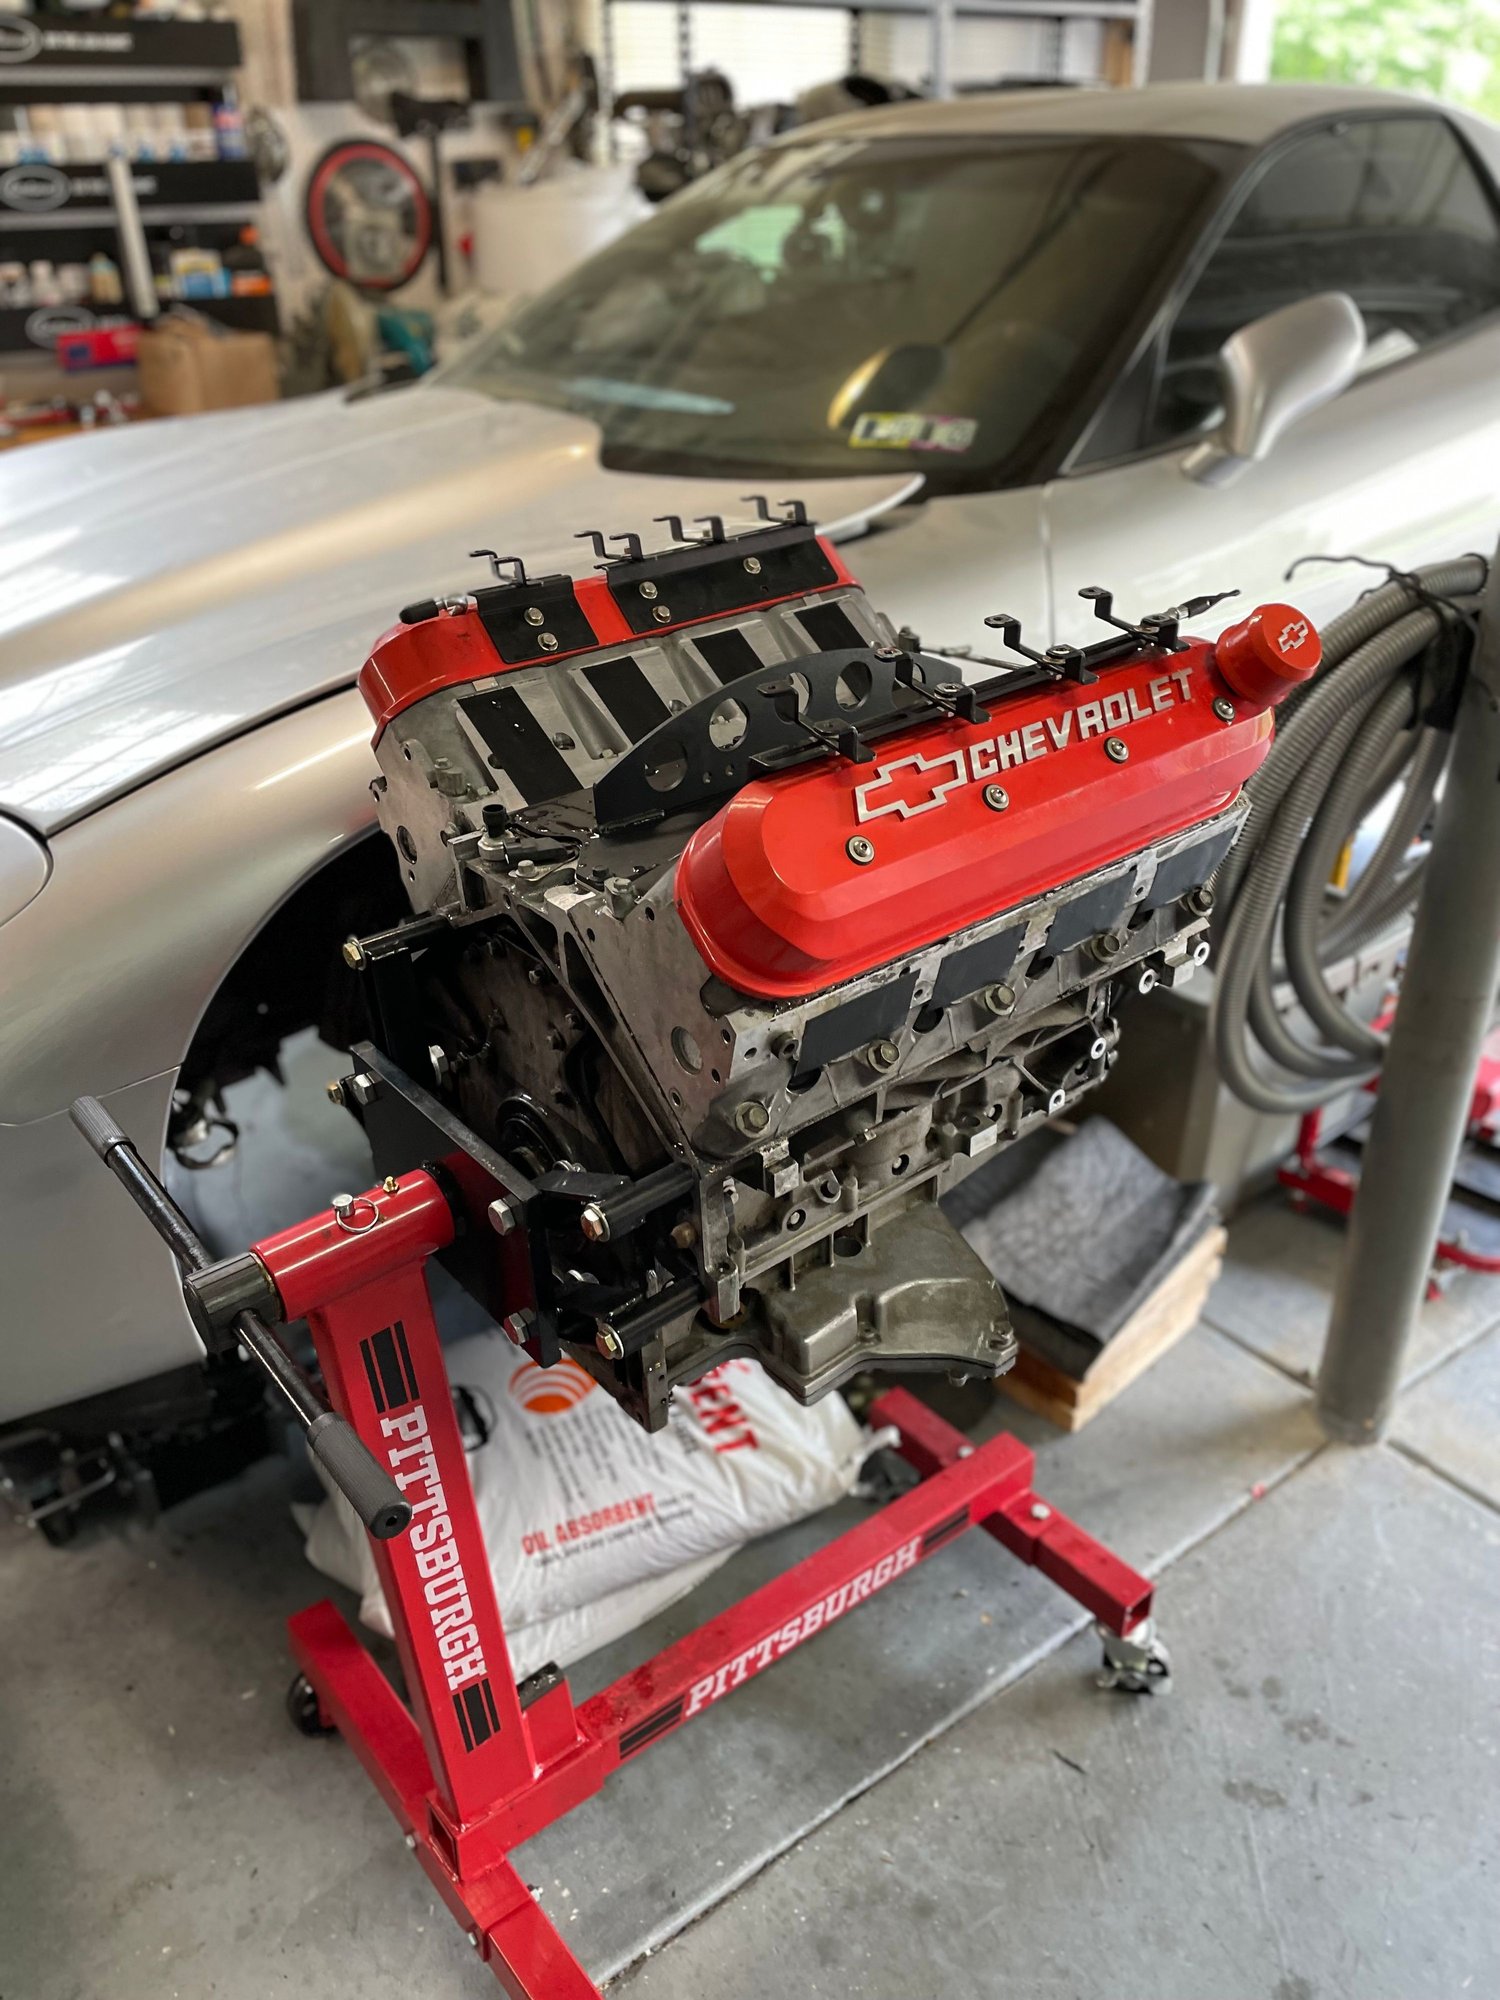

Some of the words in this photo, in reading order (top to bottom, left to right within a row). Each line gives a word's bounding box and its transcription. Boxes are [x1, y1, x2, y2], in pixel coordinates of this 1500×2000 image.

[969, 667, 1194, 780] CHEVROLET
[380, 1405, 488, 1691] PITTSBURGH
[521, 1530, 552, 1557] OIL
[555, 1491, 655, 1545] ABSORBENT
[686, 1536, 922, 1717] PITTSBURGH
